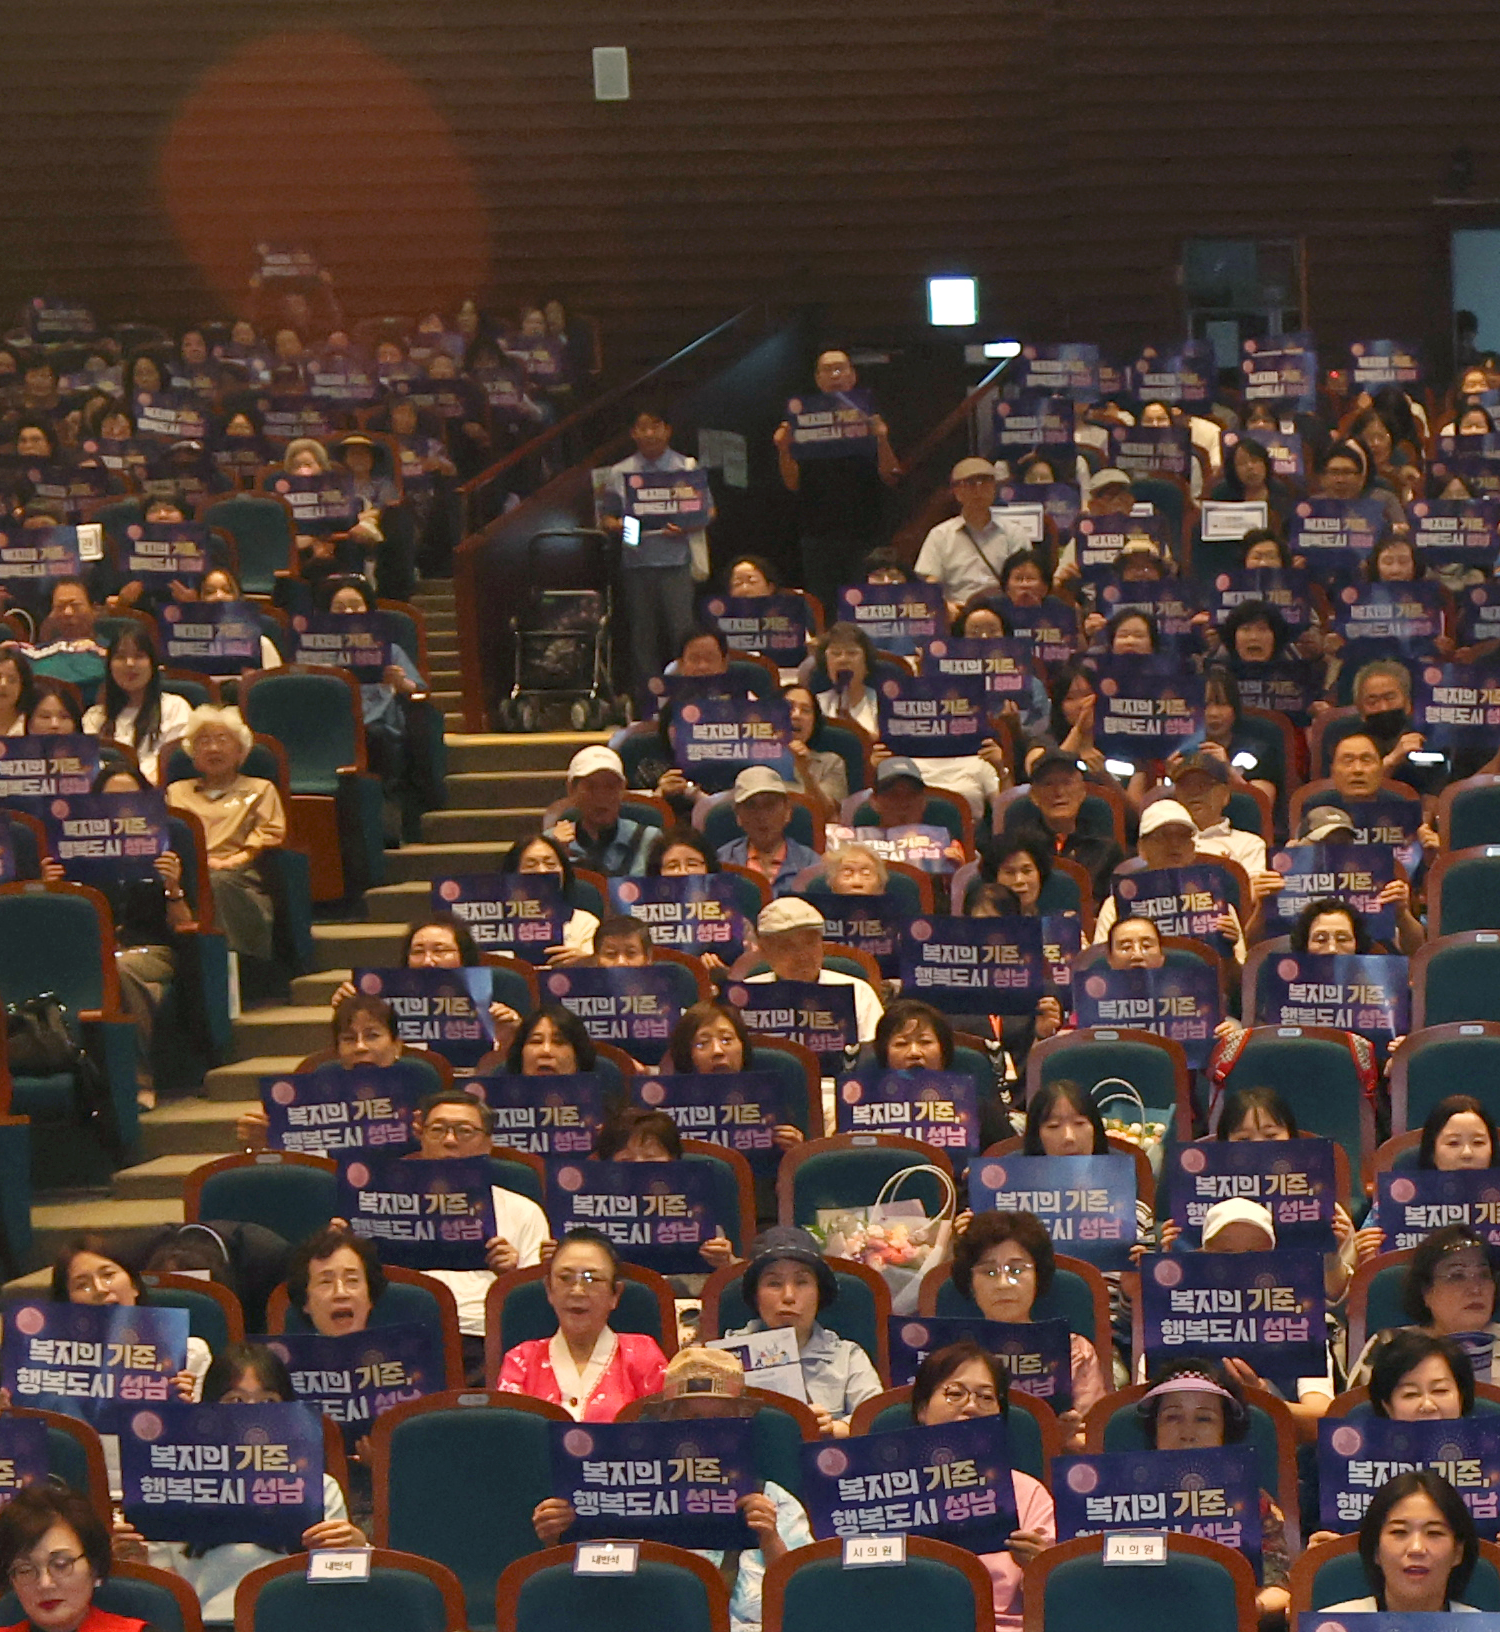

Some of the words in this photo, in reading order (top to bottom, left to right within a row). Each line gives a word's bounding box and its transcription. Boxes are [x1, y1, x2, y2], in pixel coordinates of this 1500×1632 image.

[1170, 1289, 1242, 1314] 복지의
[1161, 1318, 1256, 1344] 행복도시
[150, 1445, 230, 1471] 복지의
[581, 1460, 662, 1486] 복지의
[139, 1477, 245, 1504] 행복도시
[572, 1490, 679, 1517] 행복도시
